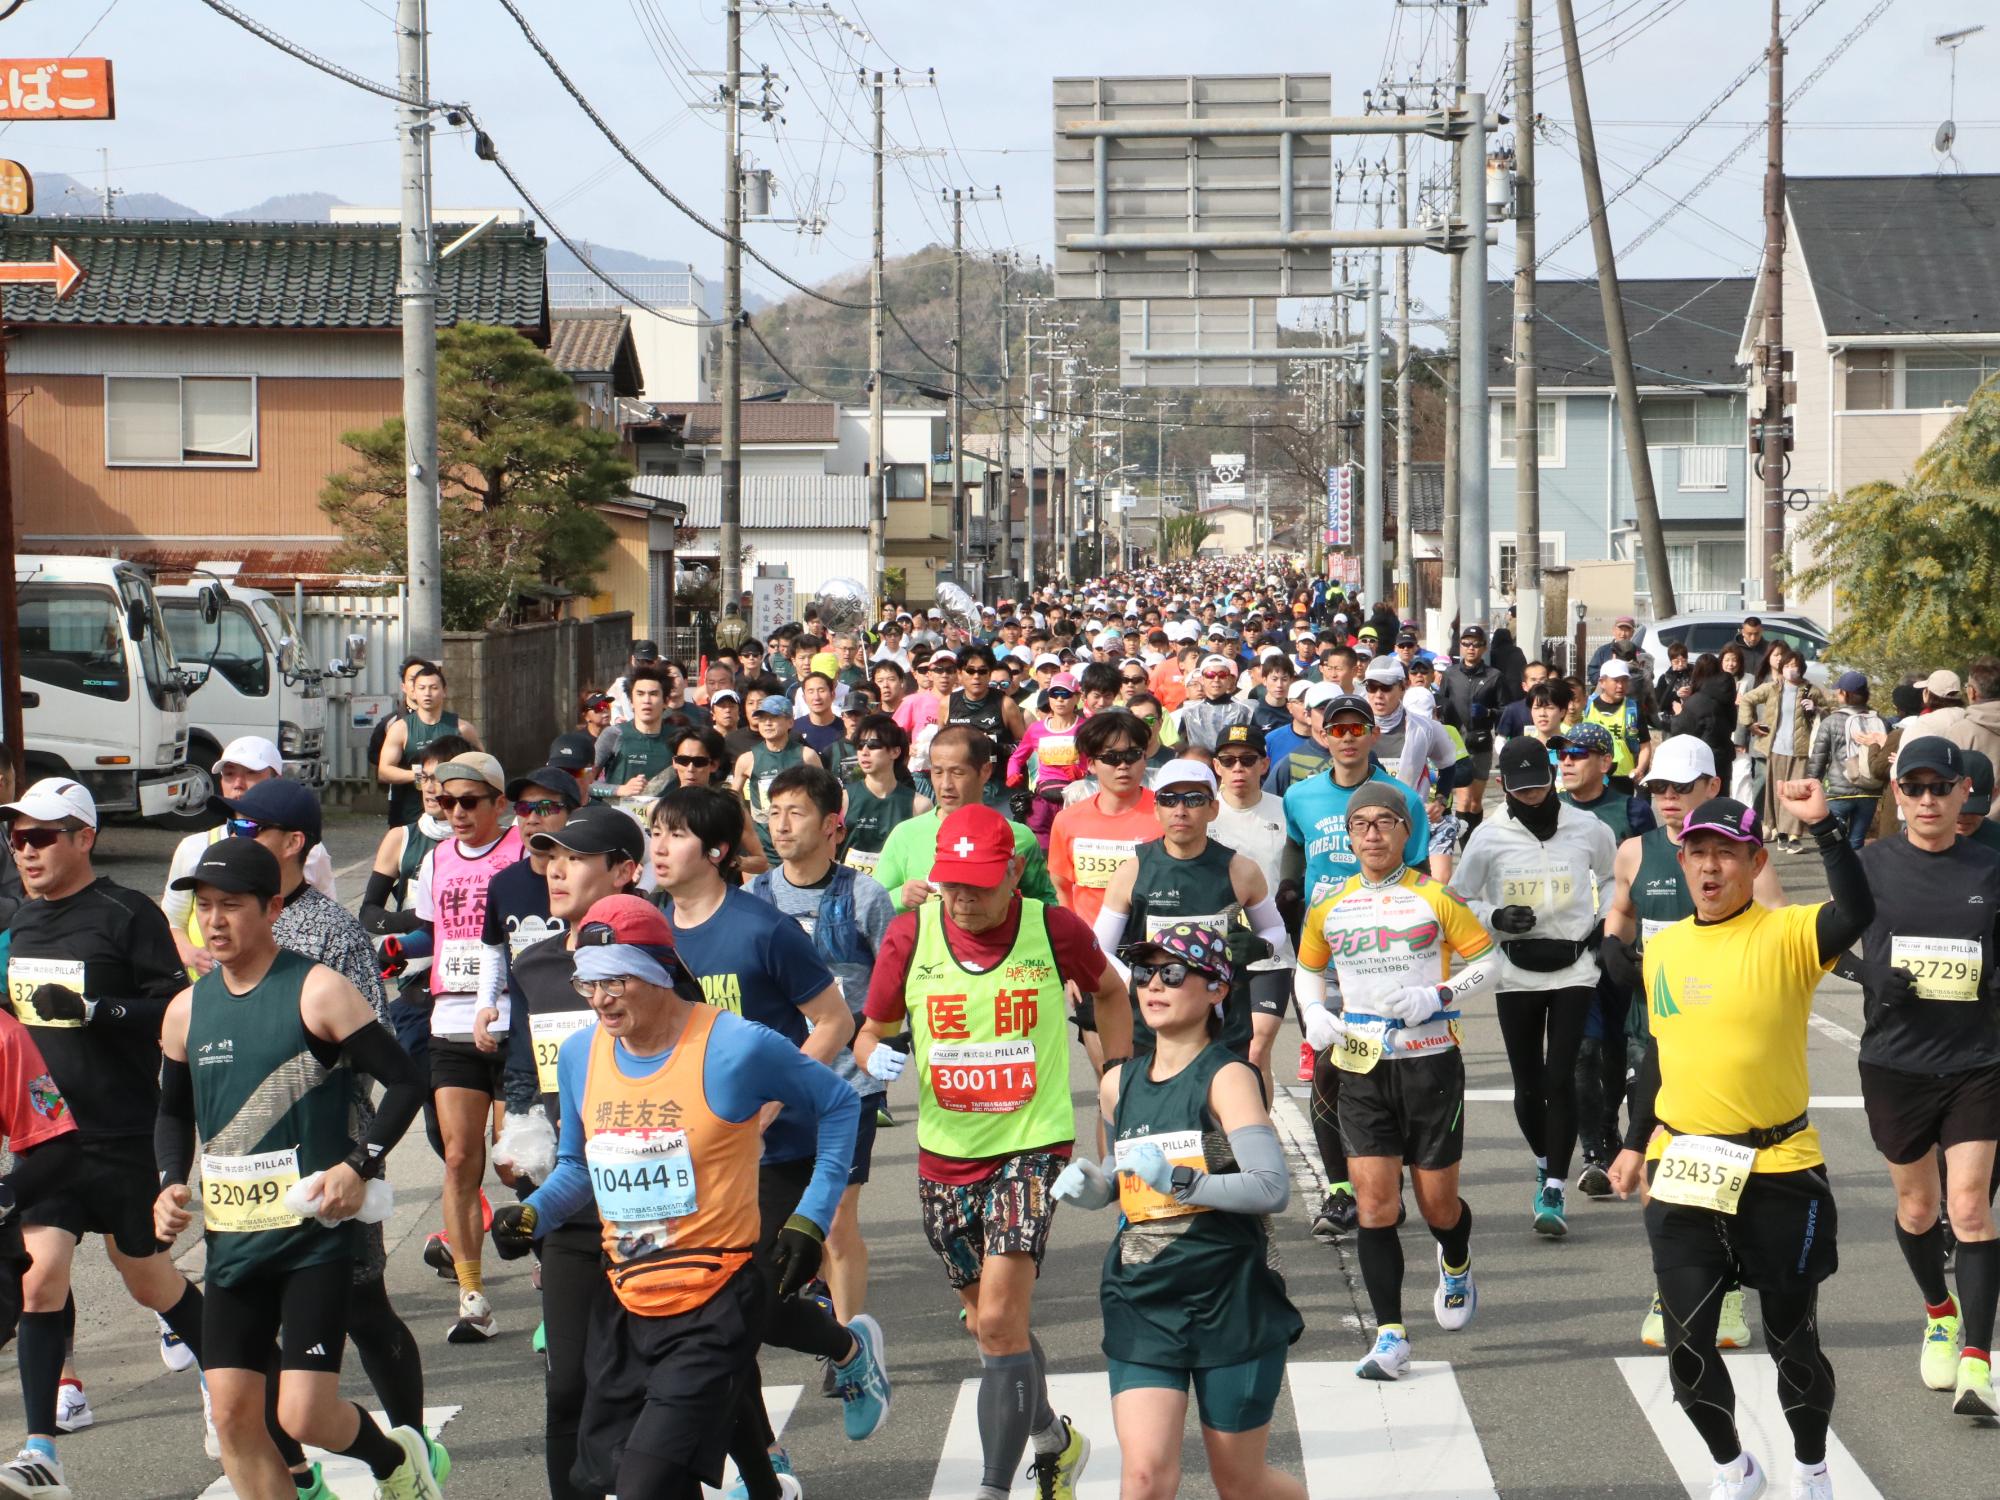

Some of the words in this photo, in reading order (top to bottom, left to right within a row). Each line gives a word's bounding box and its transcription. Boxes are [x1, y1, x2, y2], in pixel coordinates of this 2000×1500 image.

[0, 64, 95, 111] ばこ
[1315, 815, 1338, 830] WORLD
[445, 874, 484, 887] スマイル
[1507, 880, 1559, 896] 3179
[1951, 945, 1978, 953] PILLAR
[445, 957, 480, 976] 伴走
[1971, 968, 1978, 981] B
[994, 1046, 1030, 1057] PILLAR
[938, 1068, 1013, 1090] 30011
[1021, 1073, 1033, 1088] A
[596, 1099, 684, 1129] 堺走友会
[1162, 1139, 1197, 1151] PILLAR
[1714, 1145, 1750, 1161] PILLAR
[254, 1157, 293, 1171] PILLAR
[593, 1165, 671, 1193] 10444
[676, 1169, 689, 1187] B
[1662, 1158, 1728, 1185] 32435
[1729, 1176, 1742, 1191] B
[210, 1181, 279, 1206] 32049
